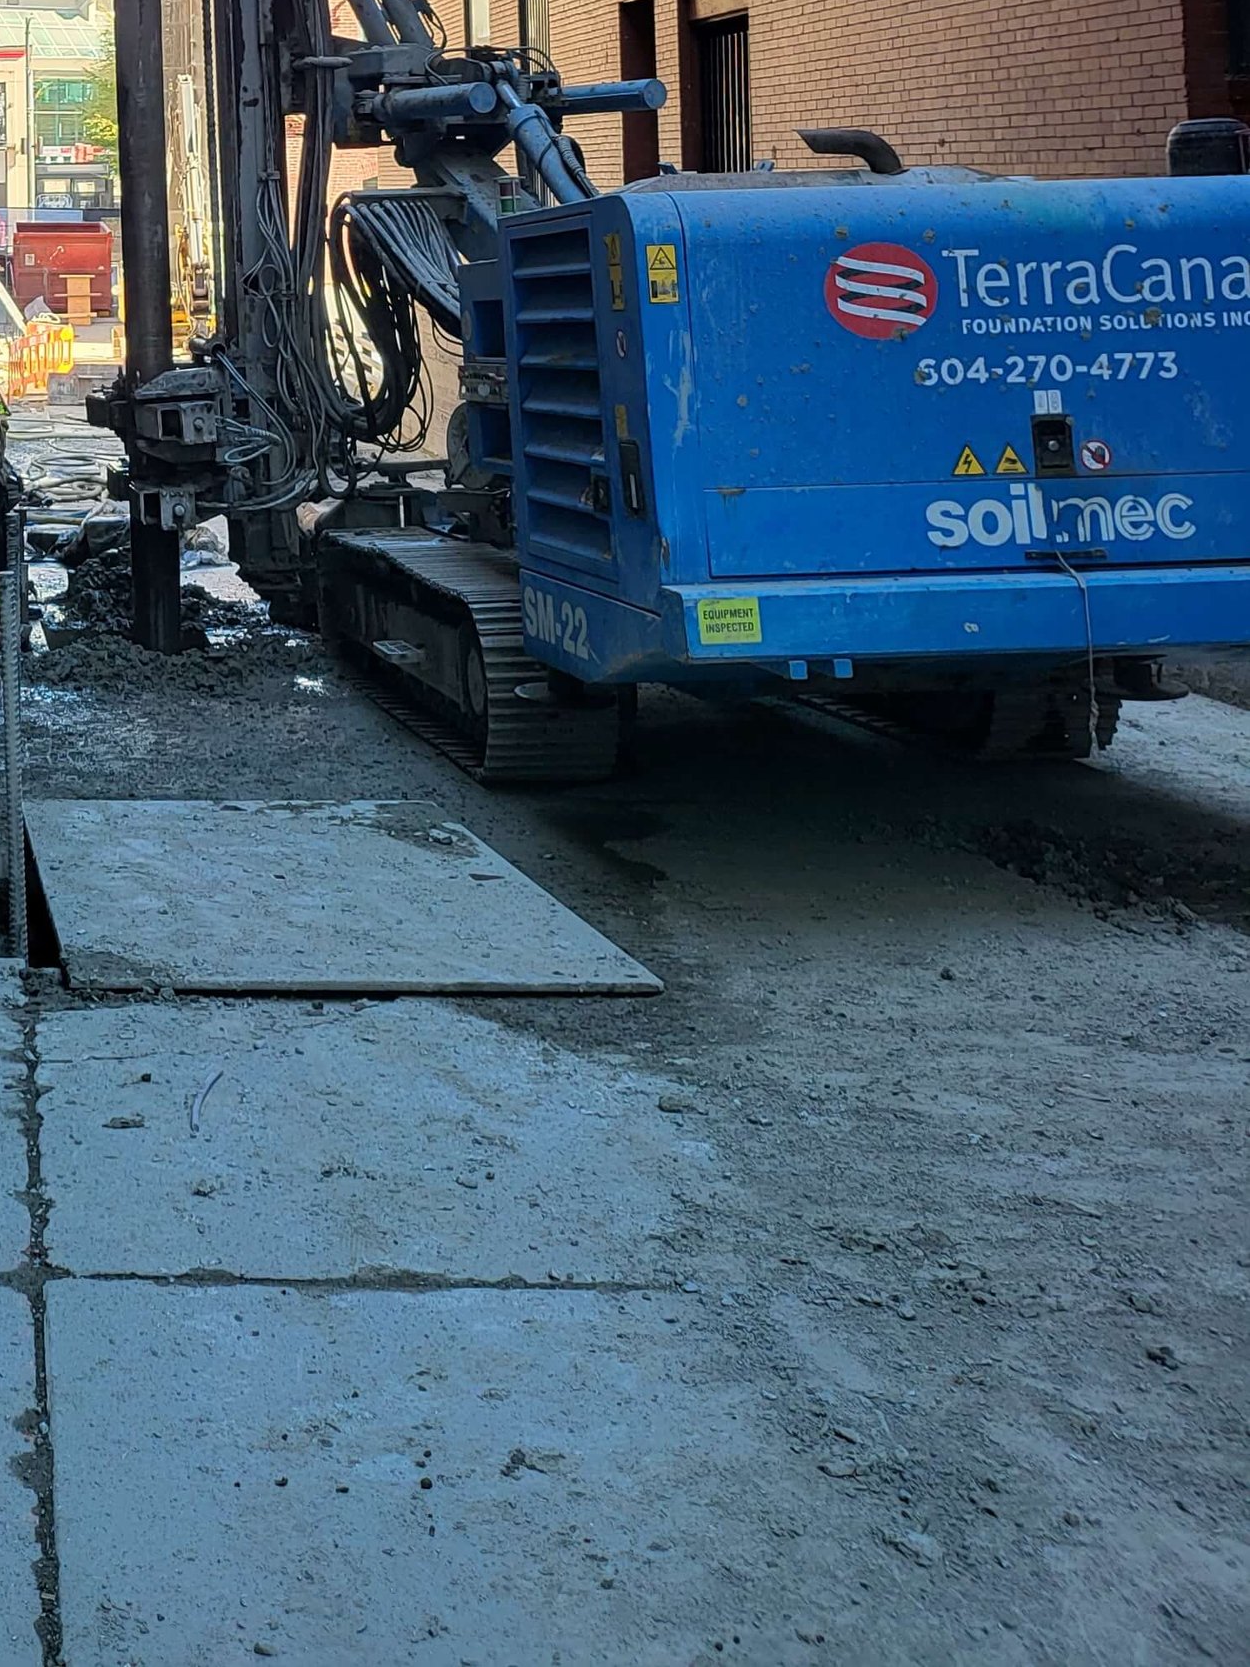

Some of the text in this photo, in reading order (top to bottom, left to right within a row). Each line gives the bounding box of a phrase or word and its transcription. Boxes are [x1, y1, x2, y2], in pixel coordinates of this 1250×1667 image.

[941, 244, 1250, 308] TerraCana
[962, 316, 1092, 335] FOUNDATION
[916, 351, 1179, 386] 604-270-4773
[925, 483, 1197, 548] soilmec
[523, 585, 590, 661] SM-22
[702, 607, 754, 621] EQUIPMENT
[705, 621, 755, 634] INSPECTED
